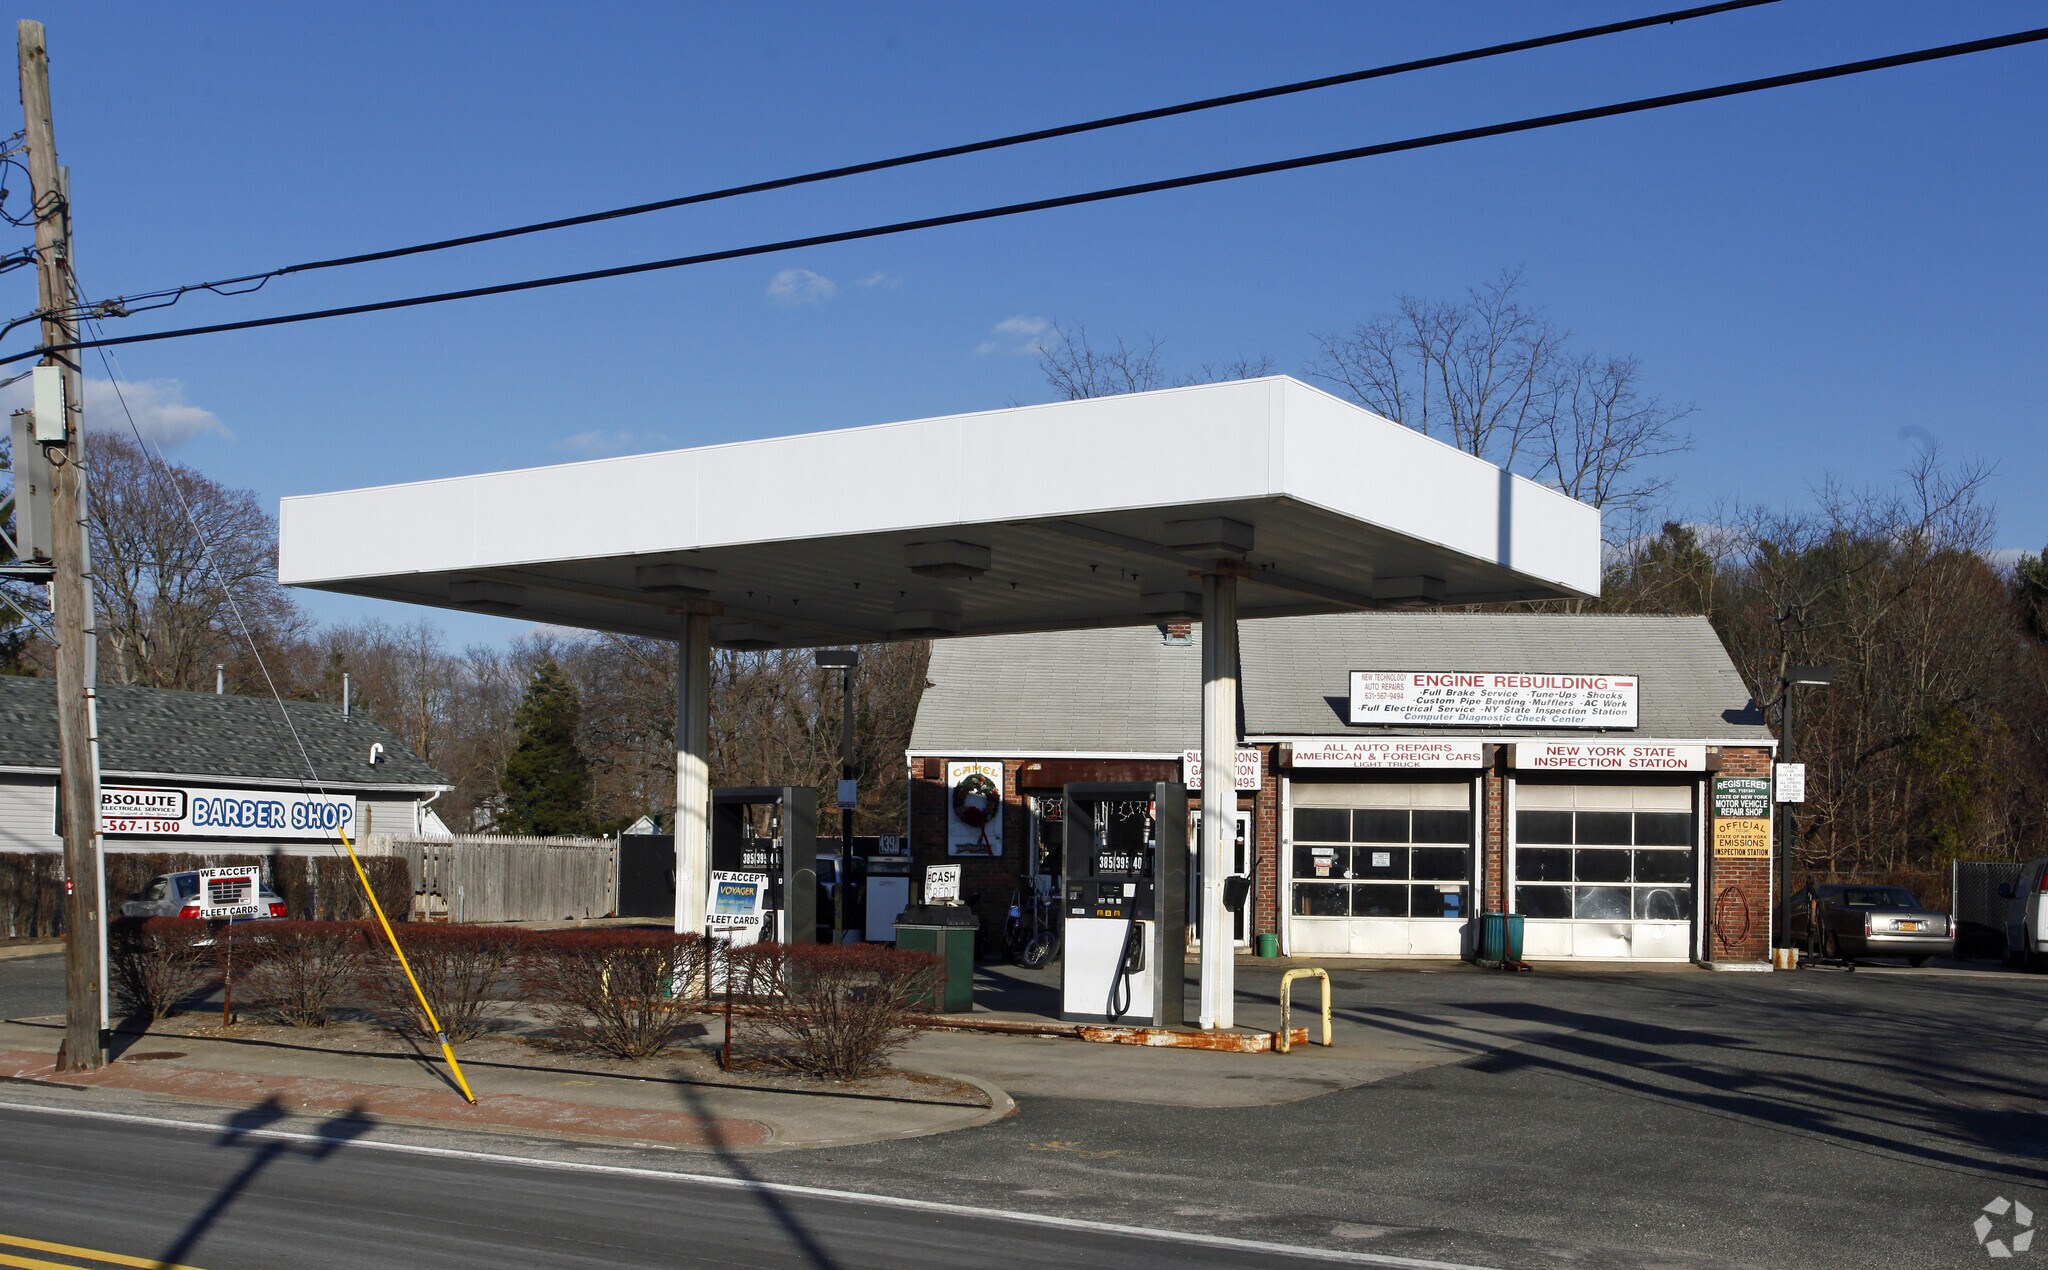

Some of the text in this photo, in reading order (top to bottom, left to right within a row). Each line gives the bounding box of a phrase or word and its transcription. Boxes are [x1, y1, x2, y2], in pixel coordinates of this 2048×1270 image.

[1374, 674, 1408, 682] TECHNOLOGY
[1413, 674, 1608, 690] ENGINE REBUILDING
[1364, 682, 1378, 690] AUTO
[1364, 692, 1404, 700] 631-567-9494
[1446, 688, 1476, 697] Brake
[1480, 690, 1518, 698] Service
[1460, 697, 1482, 706] Pipe
[1485, 698, 1526, 707] Bending
[1603, 700, 1628, 708] Work
[1384, 704, 1433, 712] Electrical
[1438, 705, 1476, 713] Service
[1504, 706, 1530, 714] State
[1536, 706, 1586, 716] Inspection
[1592, 707, 1628, 716] Station
[1404, 712, 1586, 724] Computer Diagnostic Check Center
[1324, 744, 1452, 752] ALL AUTO REPAIRS
[1546, 746, 1676, 757] NEW YORK STATE
[1295, 752, 1481, 762] AMERICAN & FOREIGN CARS
[1534, 758, 1688, 768] INSPECTION STATION
[952, 764, 998, 778] CAMEL
[1717, 780, 1767, 790] REGISTERED
[102, 794, 176, 806] BSOLUTE
[1716, 800, 1768, 808] MOTOR VEHICLE
[193, 798, 352, 830] BARBER SHOP
[1721, 808, 1763, 816] REPAIR SHOP
[102, 820, 180, 832] -567-1500
[1719, 821, 1766, 833] OFFICIAL
[1099, 856, 1113, 869] 385
[1133, 857, 1142, 869] 40
[200, 866, 258, 878] WE ACCEPT
[713, 872, 766, 882] WE ACCEPT
[931, 871, 956, 883] CASH
[720, 886, 755, 896] VOYAGER
[200, 906, 258, 917] FLEET CARDS
[706, 914, 760, 925] FLEET CARDS
